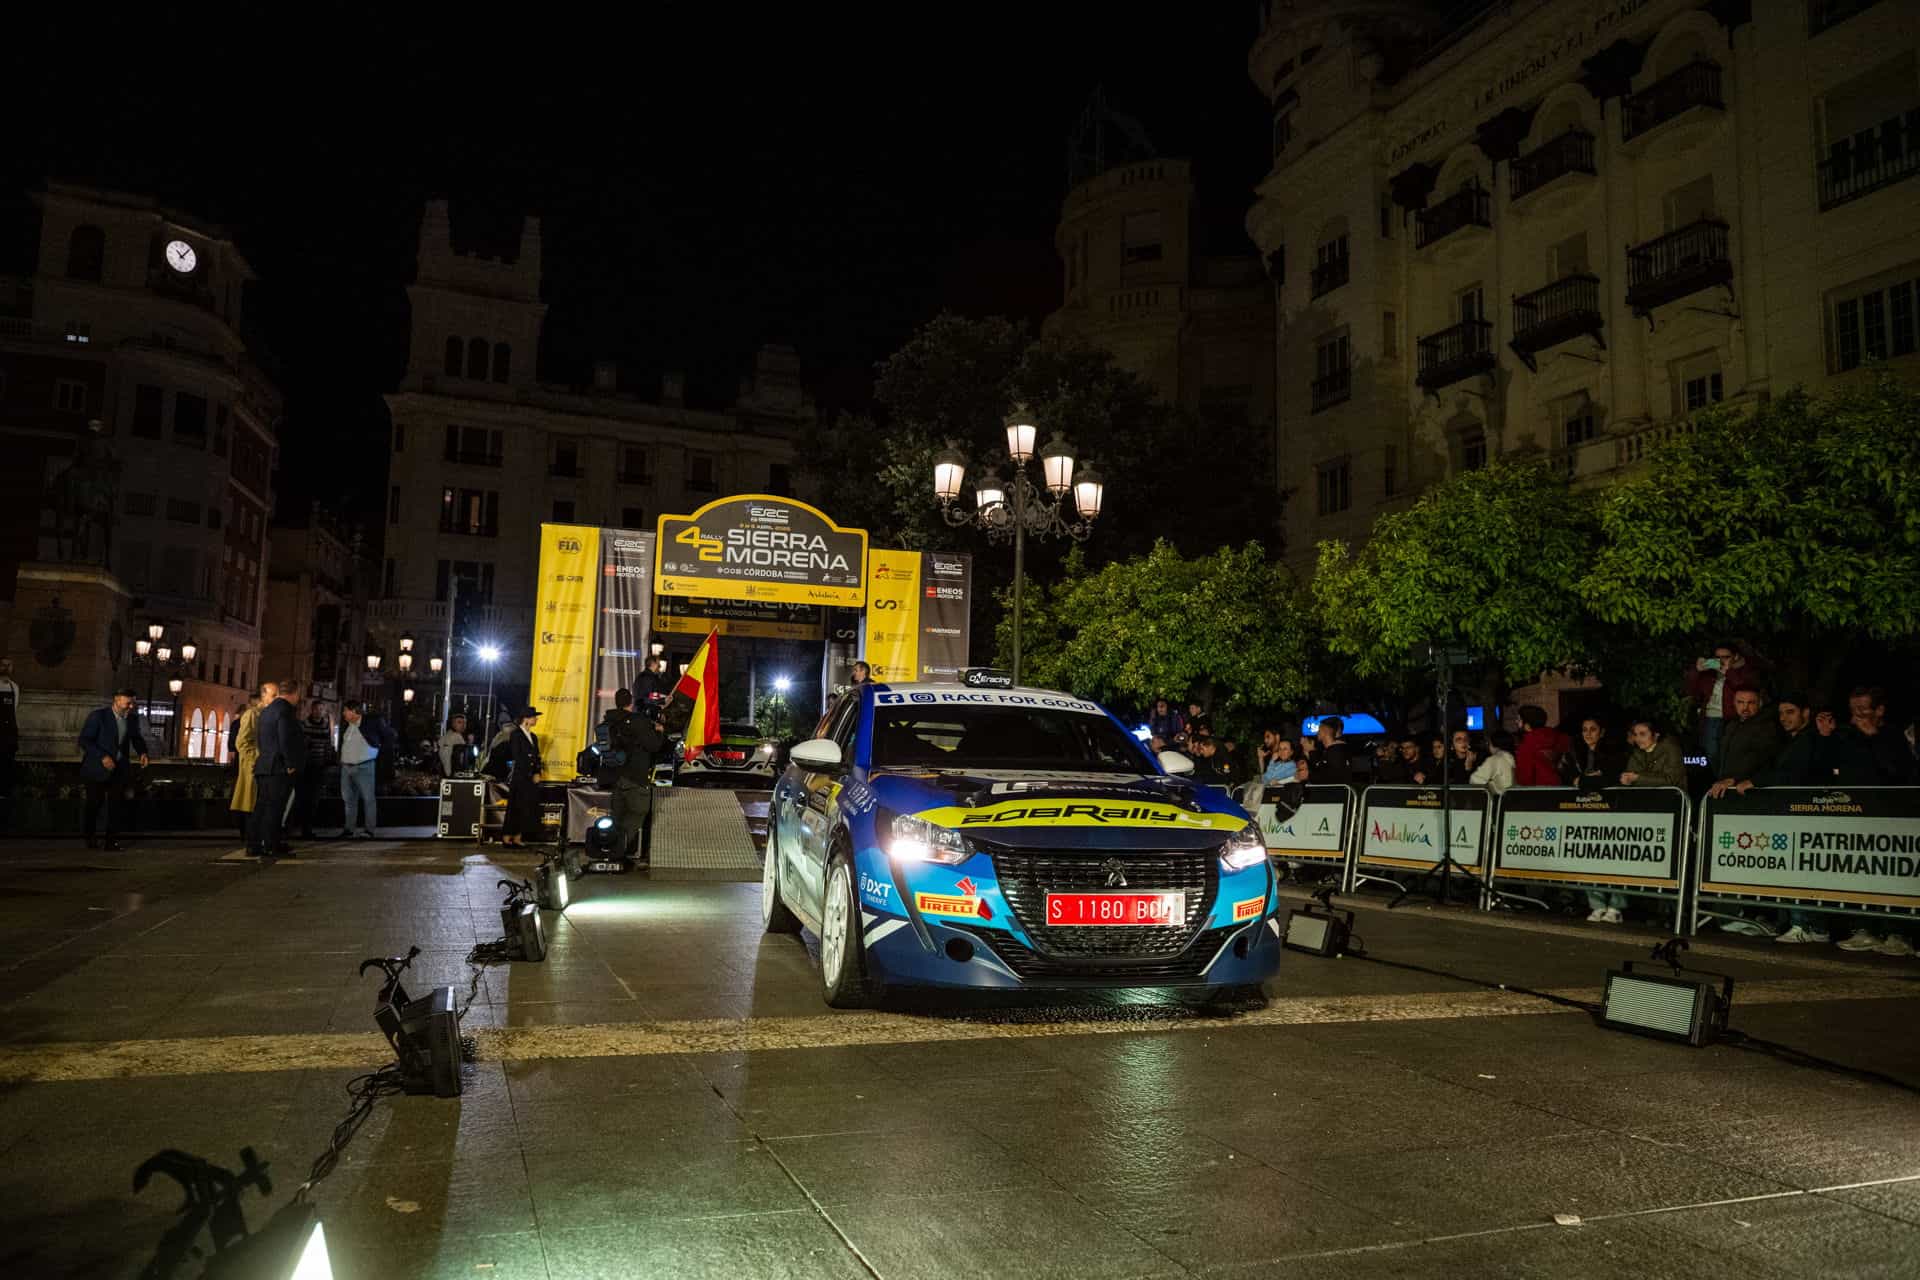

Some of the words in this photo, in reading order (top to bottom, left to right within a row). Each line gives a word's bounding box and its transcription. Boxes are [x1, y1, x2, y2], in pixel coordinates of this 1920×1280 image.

[727, 529, 827, 552] SIERRA
[726, 548, 849, 573] MORENA
[936, 587, 964, 596] ENEOS
[942, 693, 993, 702] RACE
[998, 695, 1037, 705] FOR
[1042, 698, 1096, 711] GOOD
[1790, 803, 1821, 813] SIERRA
[1824, 804, 1863, 814] MORENA
[1371, 820, 1433, 847] Andalucía
[1565, 825, 1654, 843] PATRIMONIO
[1656, 828, 1666, 836] DE
[1506, 842, 1556, 861] CÓRDOBA
[1564, 843, 1666, 864] HUMANIDAD
[1718, 852, 1786, 870] CÓRDOBA
[866, 878, 892, 898] DXT
[919, 896, 975, 914] PIRELLI
[1052, 900, 1063, 919] S
[1078, 900, 1124, 919] 1180
